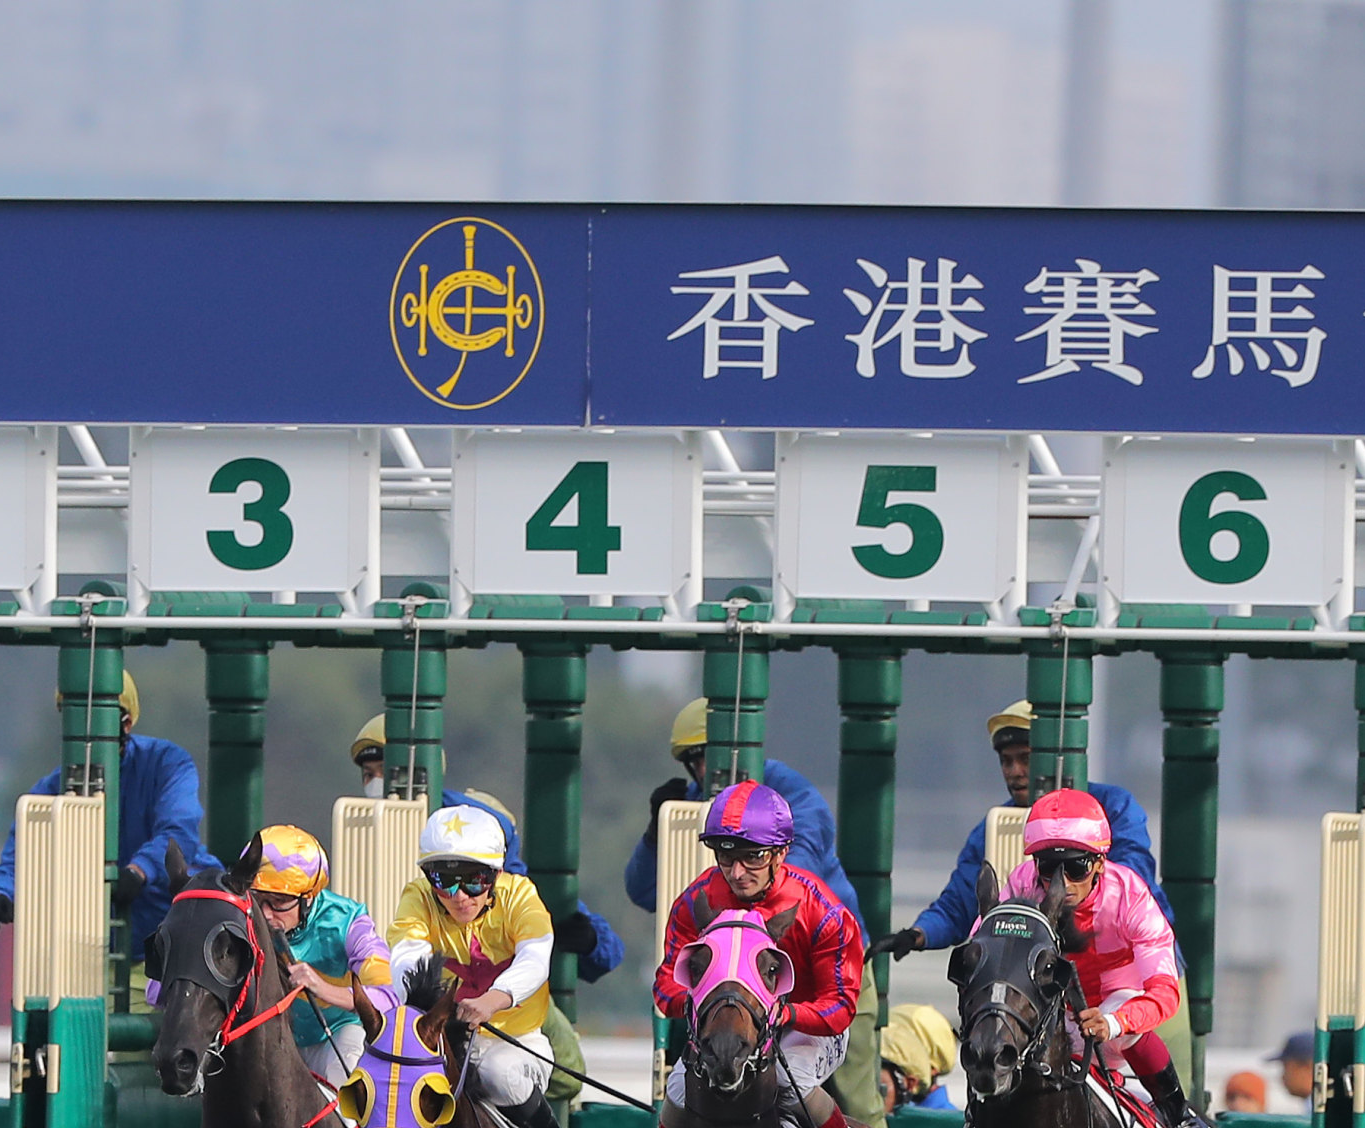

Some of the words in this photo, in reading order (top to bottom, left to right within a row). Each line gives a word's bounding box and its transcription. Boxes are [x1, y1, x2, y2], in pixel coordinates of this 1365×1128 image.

[207, 457, 294, 571] 3
[526, 461, 622, 575] 4
[853, 465, 944, 579] 5
[1179, 471, 1270, 584] 6
[995, 920, 1027, 930] Hayes
